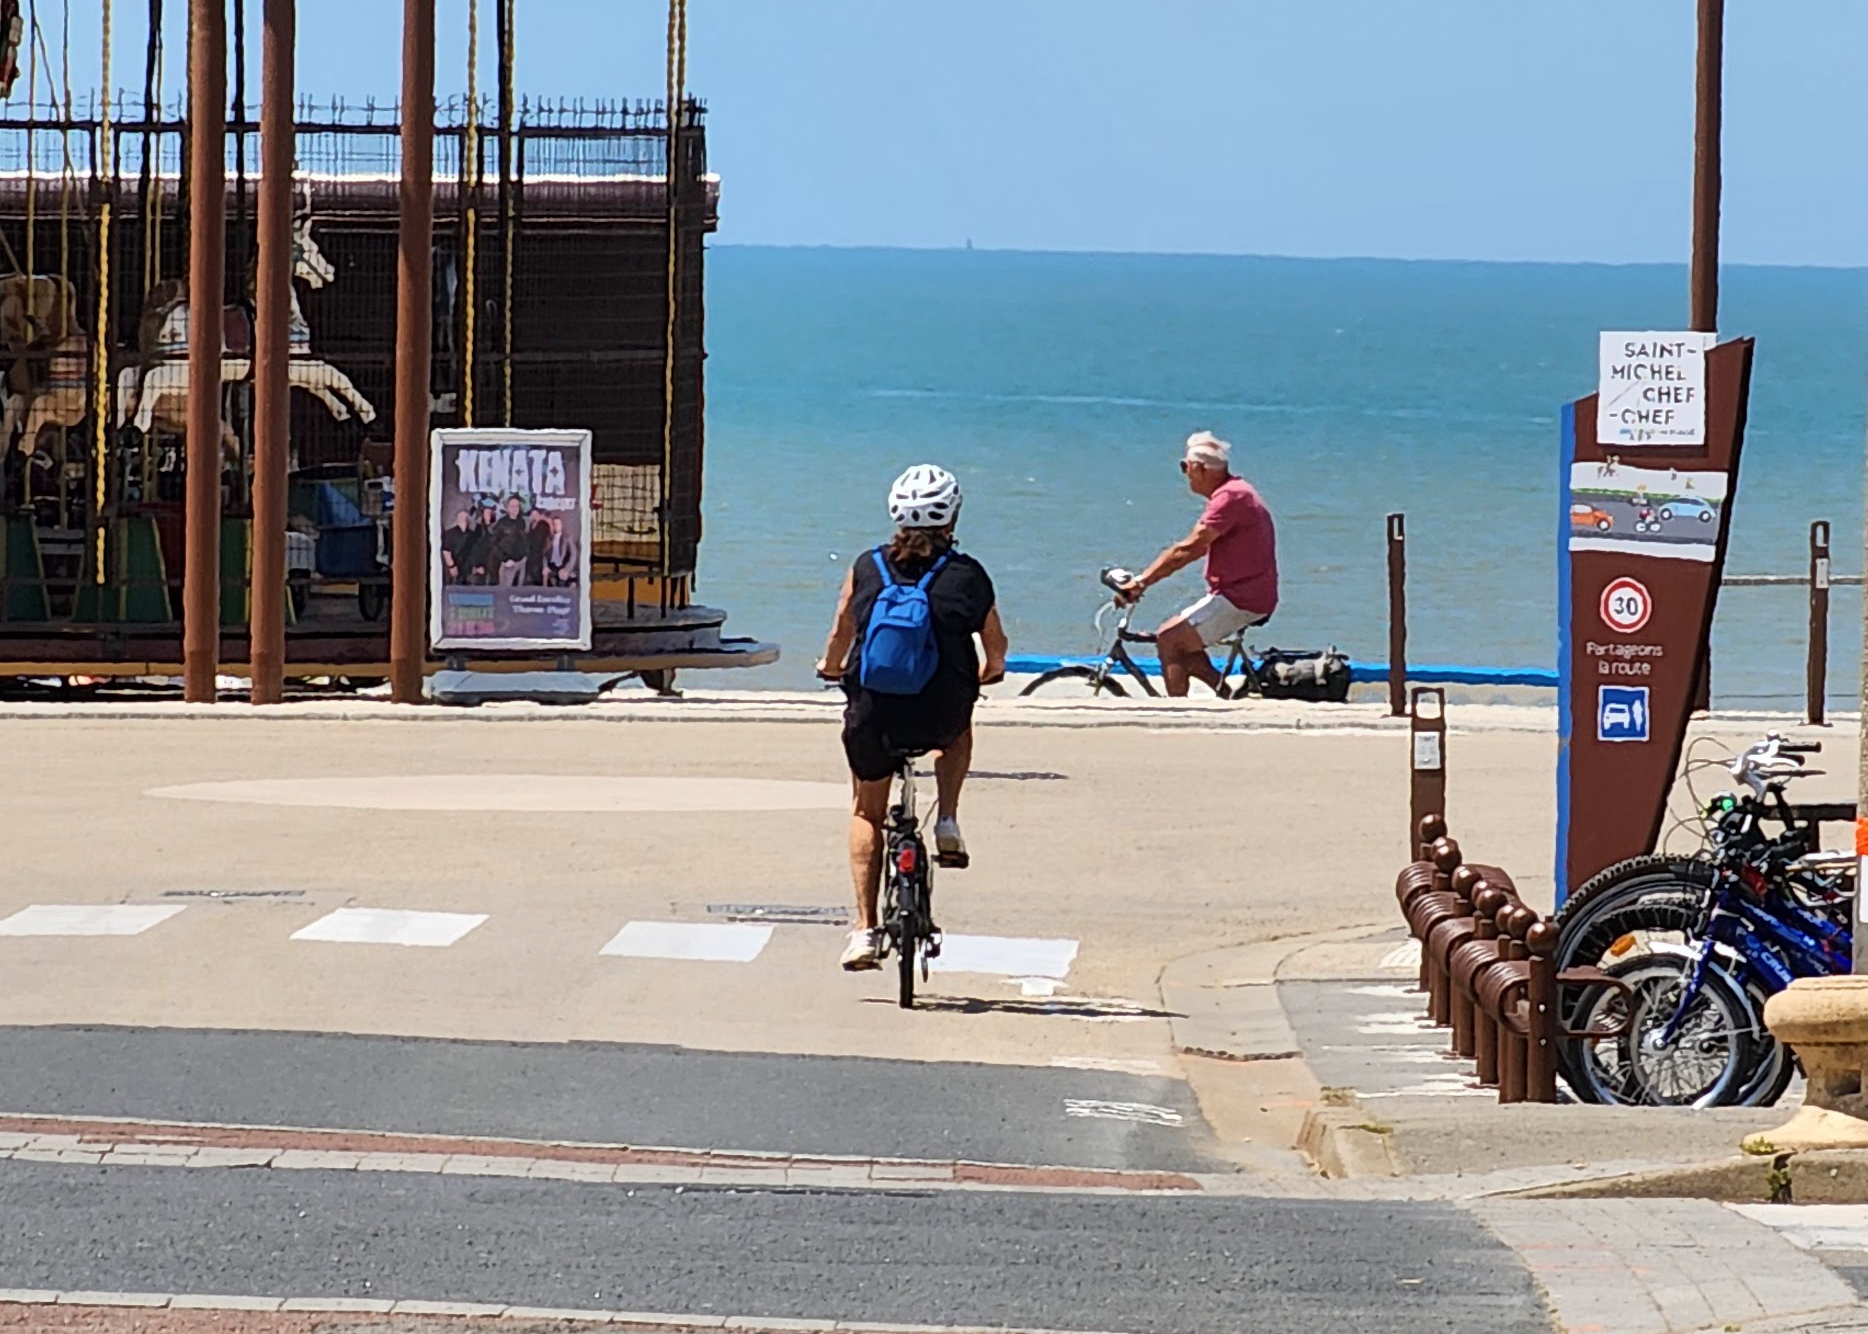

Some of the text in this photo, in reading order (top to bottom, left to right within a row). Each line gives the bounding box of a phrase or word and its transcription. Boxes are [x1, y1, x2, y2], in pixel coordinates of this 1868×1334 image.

[1624, 342, 1697, 358] SAINT-
[1611, 363, 1687, 381] MICHEL
[1642, 386, 1695, 403] CHEF
[1609, 408, 1675, 425] -CHEF
[1613, 596, 1638, 616] 30
[1586, 641, 1663, 659] Partageons
[1598, 660, 1651, 675] la route
